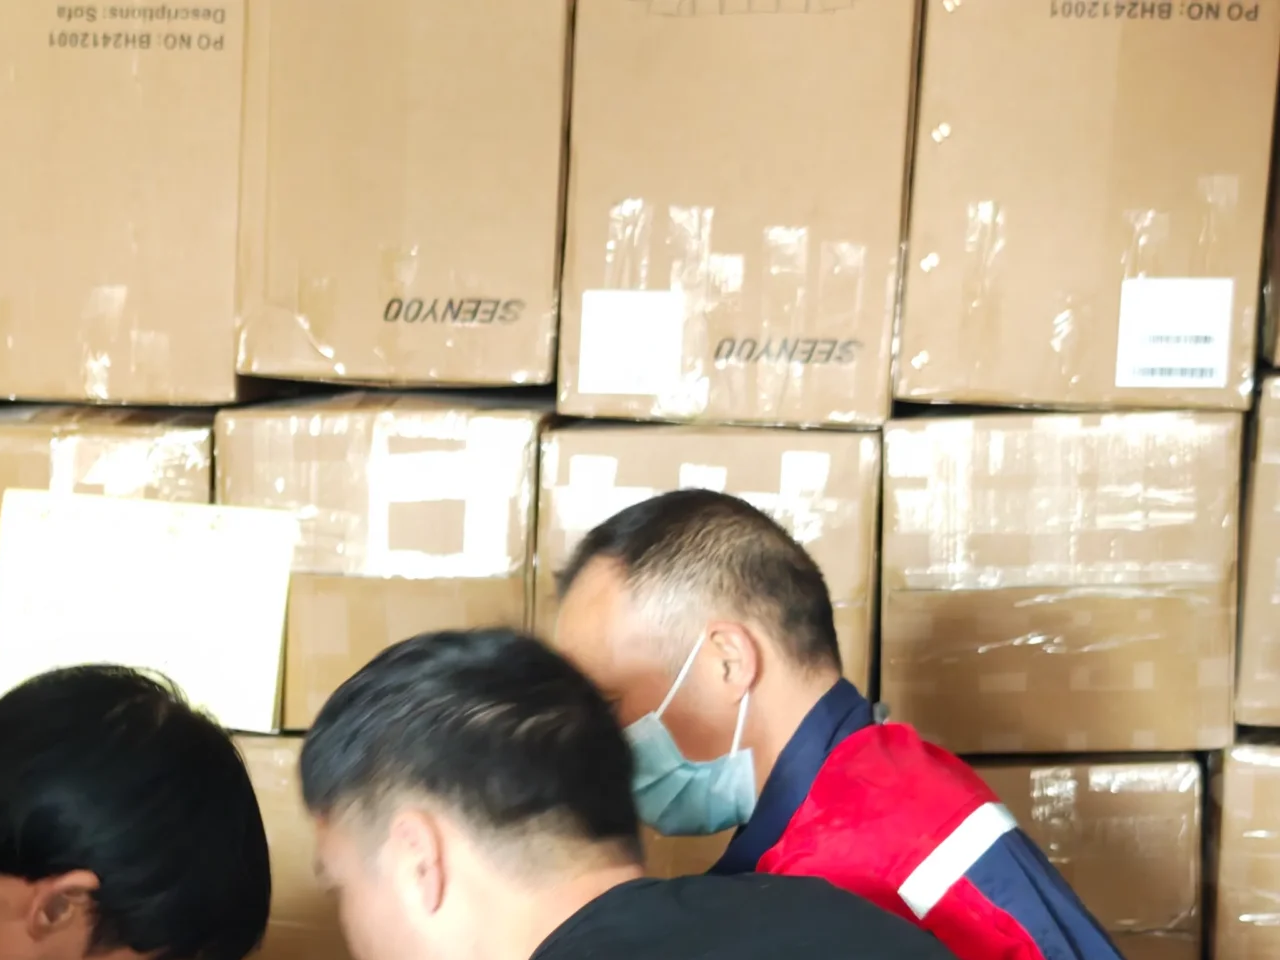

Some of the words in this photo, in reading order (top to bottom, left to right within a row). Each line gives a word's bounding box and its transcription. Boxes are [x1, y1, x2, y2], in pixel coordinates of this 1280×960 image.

[56, 5, 97, 22] Sofa
[1049, 2, 1172, 20] BH2412001
[1226, 4, 1260, 21] PO
[48, 31, 152, 49] BH2412001
[196, 34, 225, 50] PO
[383, 298, 526, 324] SEENYOO
[714, 337, 865, 364] SEENYOO
